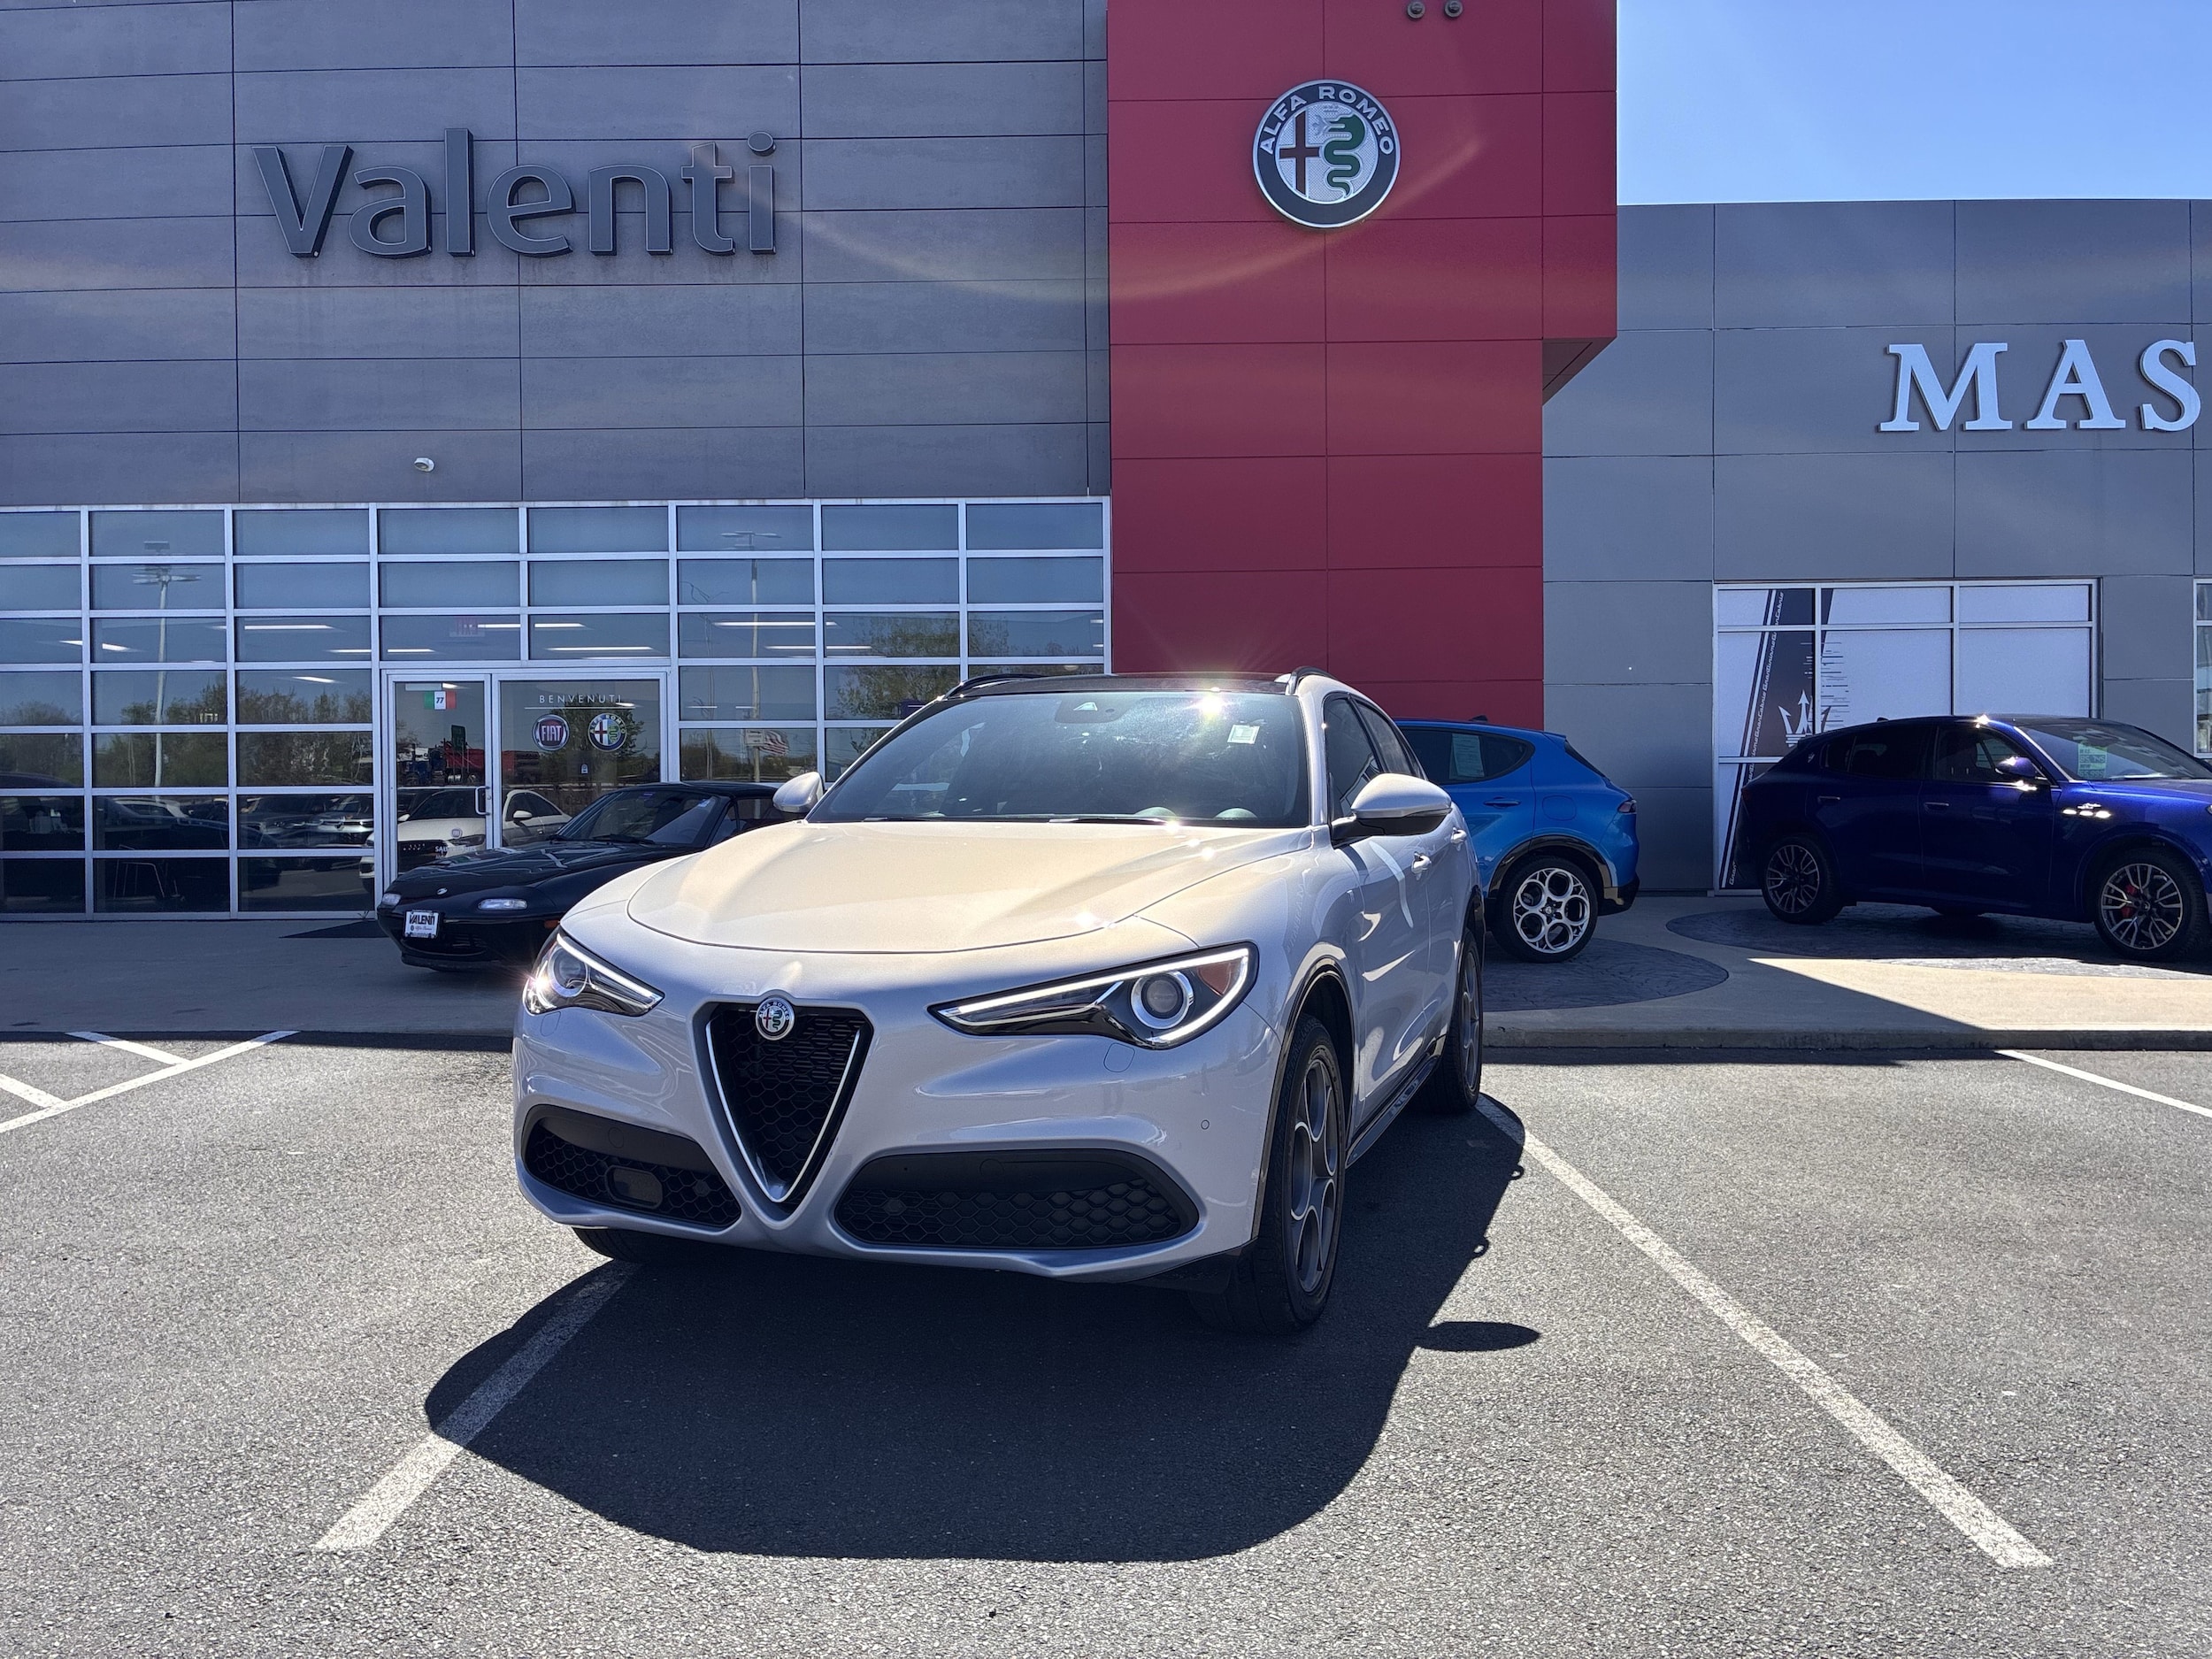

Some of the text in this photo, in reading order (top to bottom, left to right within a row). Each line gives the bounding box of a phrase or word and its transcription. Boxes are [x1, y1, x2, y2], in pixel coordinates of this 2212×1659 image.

[1259, 86, 1394, 155] ALFA ROMEO
[251, 128, 776, 257] Valenti
[1878, 339, 2201, 431] MAS
[539, 695, 621, 703] BENVENUTI
[541, 726, 562, 741] FIAT
[605, 714, 626, 733] ROMEO
